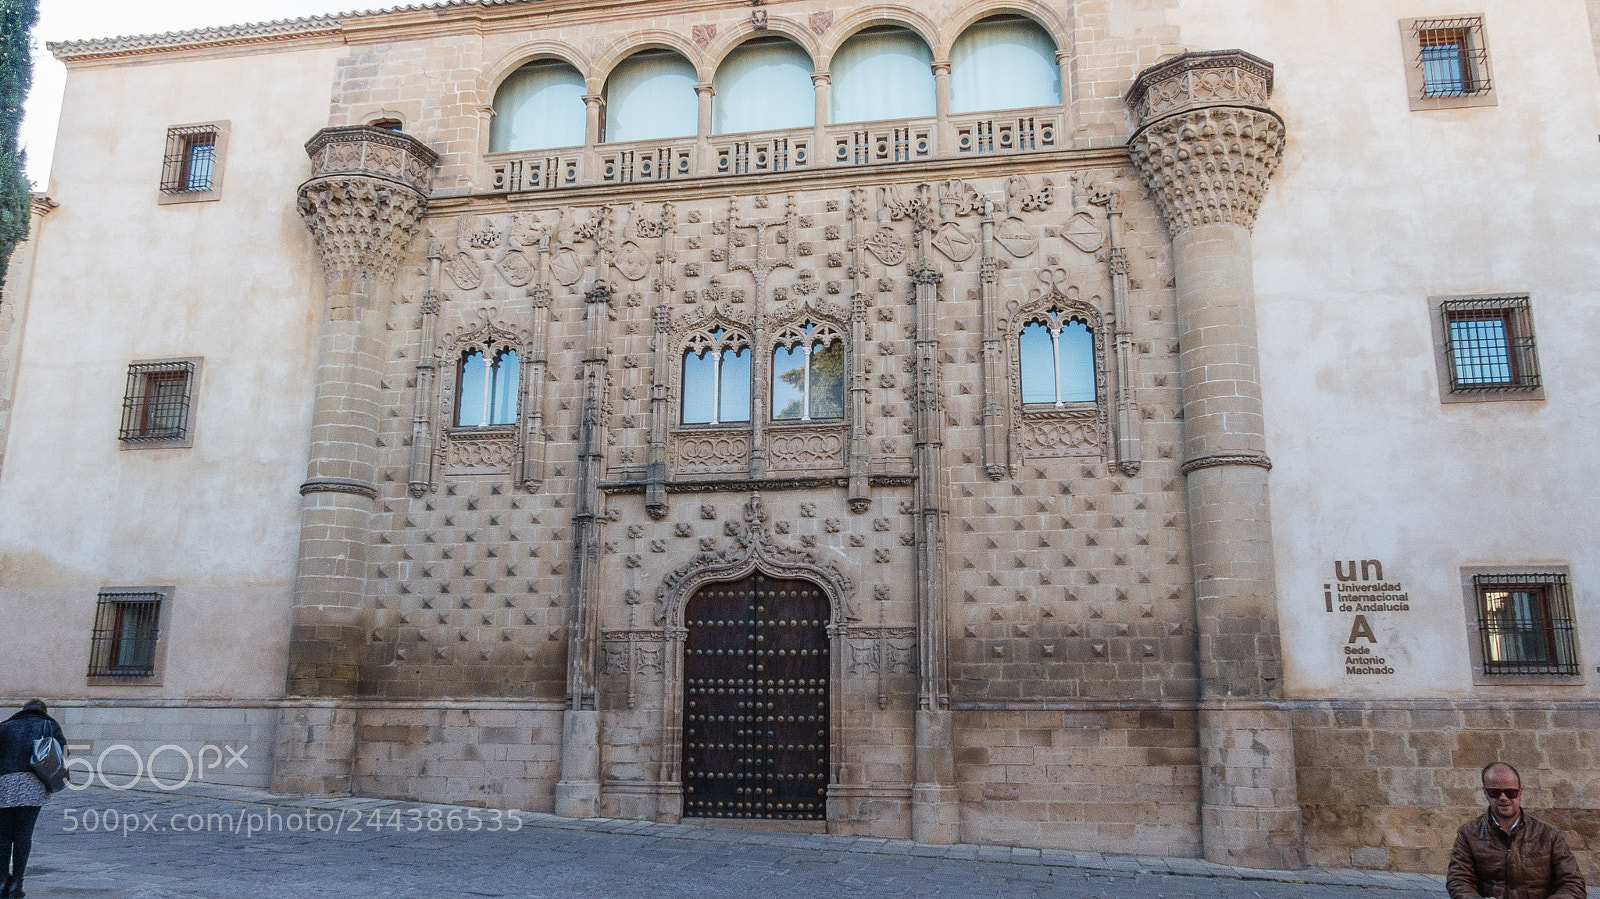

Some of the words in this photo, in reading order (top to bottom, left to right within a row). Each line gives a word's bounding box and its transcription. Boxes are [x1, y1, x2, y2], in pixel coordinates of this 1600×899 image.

[1334, 559, 1384, 582] un
[1337, 582, 1402, 592] Universidad
[1338, 592, 1409, 602] Internacional
[1339, 603, 1353, 612] de
[1355, 602, 1410, 612] Andalucía
[1348, 614, 1378, 644] A
[1344, 646, 1371, 655] Sede
[1345, 656, 1386, 665] Antonio
[1346, 665, 1395, 675] Machado
